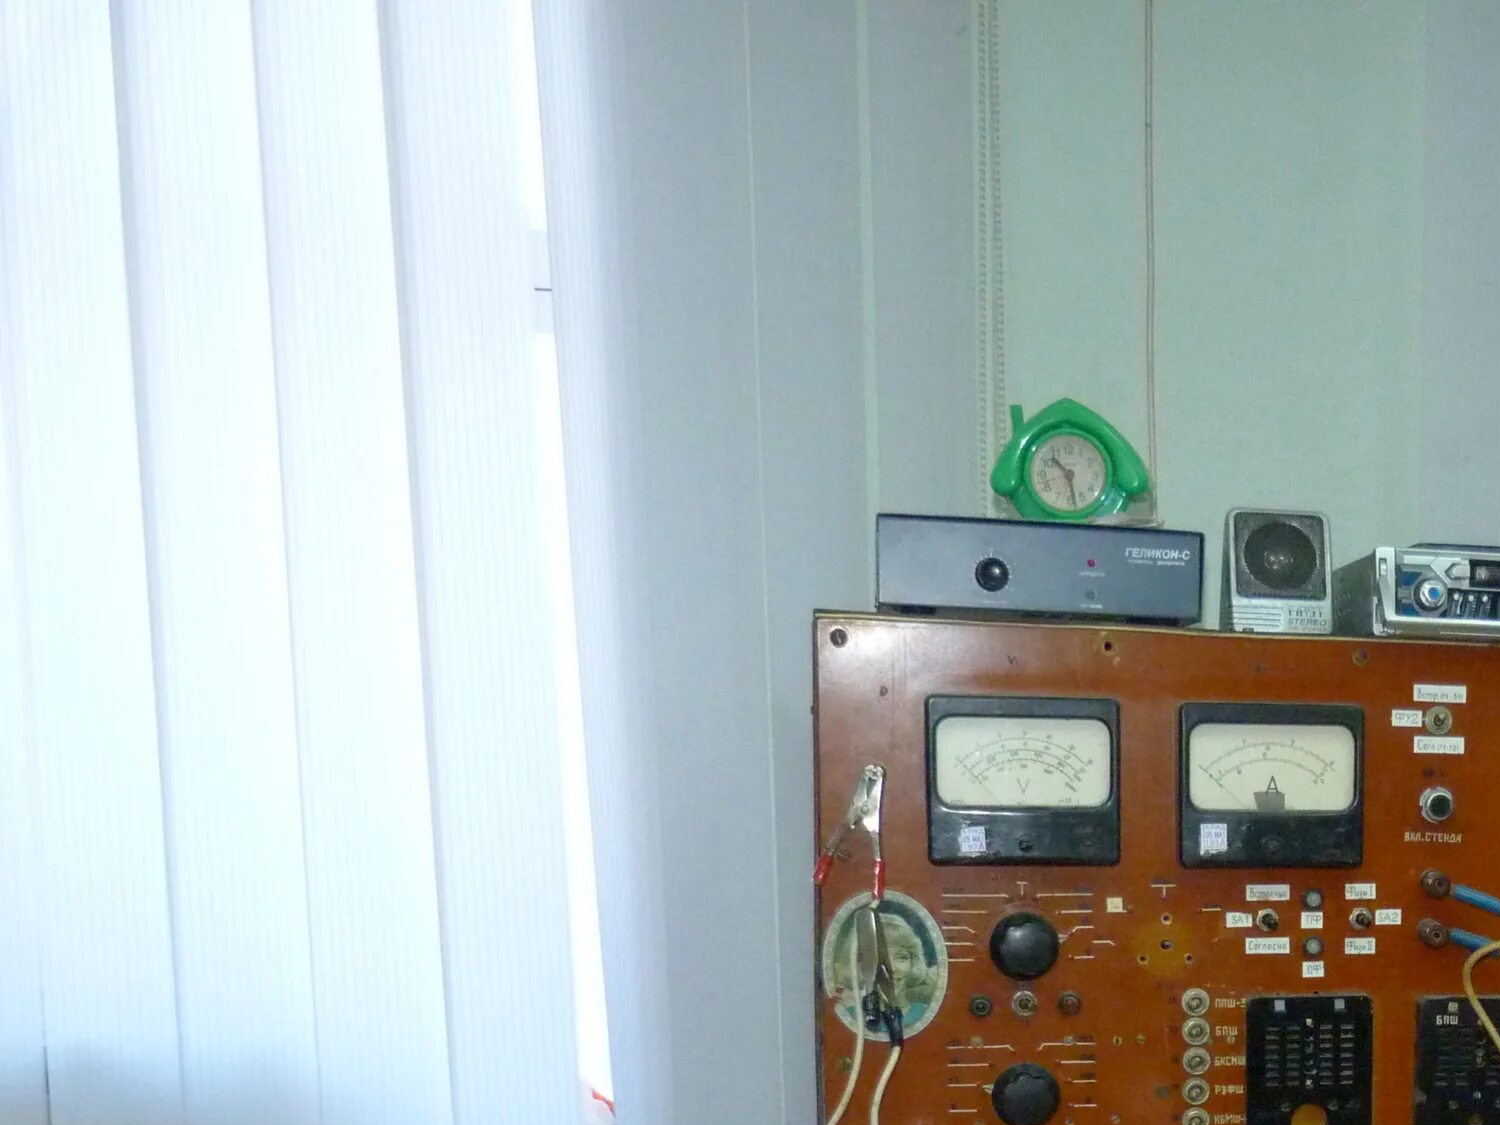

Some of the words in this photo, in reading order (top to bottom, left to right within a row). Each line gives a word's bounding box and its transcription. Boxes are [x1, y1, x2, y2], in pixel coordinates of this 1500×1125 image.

[1125, 547, 1191, 560] ГЕЛИКОН-С
[1287, 619, 1327, 627] STEREO
[1016, 778, 1031, 795] V
[1265, 775, 1280, 795] A
[1231, 914, 1250, 925] SA1
[1305, 914, 1321, 926] ПФ
[1377, 912, 1399, 923] SA2
[1436, 1015, 1459, 1025] БПШ
[1216, 1025, 1238, 1036] БПШ
[1213, 1113, 1247, 1125] КБМШ-
